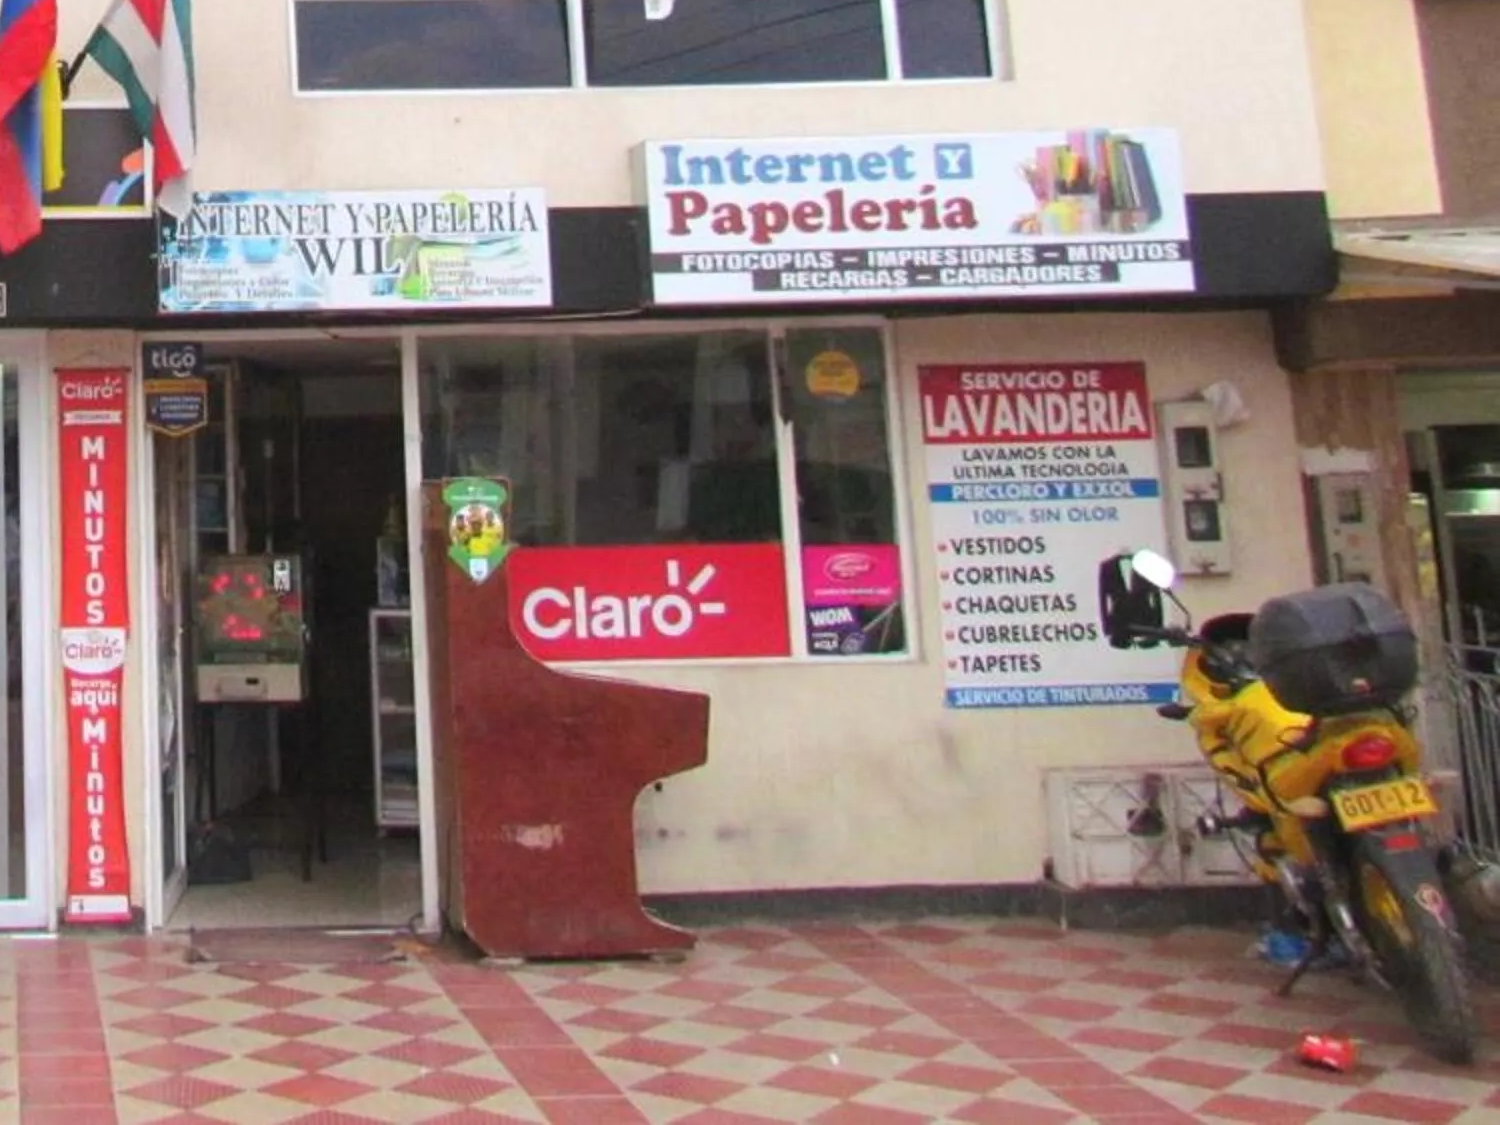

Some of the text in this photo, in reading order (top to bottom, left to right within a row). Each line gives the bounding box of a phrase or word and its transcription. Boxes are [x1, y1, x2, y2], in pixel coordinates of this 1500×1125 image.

[660, 144, 968, 186] Internet Y
[340, 202, 363, 234] Y
[374, 193, 539, 235] PAPELERÍA
[664, 184, 978, 245] Papelería
[681, 242, 1180, 272] FOTOCOPIAS IMPRESIONES MINUTOS
[780, 264, 1102, 289] RECARGAS CARGADORES
[960, 370, 1101, 390] SERVICIO DE
[61, 381, 113, 400] Claro
[924, 392, 1148, 439] LAVANDERIA
[962, 445, 1117, 462] LAVAMOS CON LA
[953, 463, 1129, 480] ULTIMA TECNOLOGIA
[952, 481, 1137, 501] PERCLORO Y EXXOL
[972, 506, 1119, 525] 100% SIN OLOR
[80, 435, 106, 625] MINUTOS
[950, 537, 1046, 555] VESTIDOS
[953, 566, 1055, 585] CORTINAS
[522, 586, 692, 640] Claro
[956, 594, 1077, 615] CHAQUETAS
[810, 607, 853, 627] WOM
[958, 623, 1098, 644] CUBRELECHOS
[65, 643, 113, 659] Claro
[960, 654, 1042, 673] TAPETES
[70, 682, 117, 715] aquí
[956, 688, 1024, 704] SERVICIO
[1027, 688, 1048, 704] DE
[81, 718, 107, 888] Minutos
